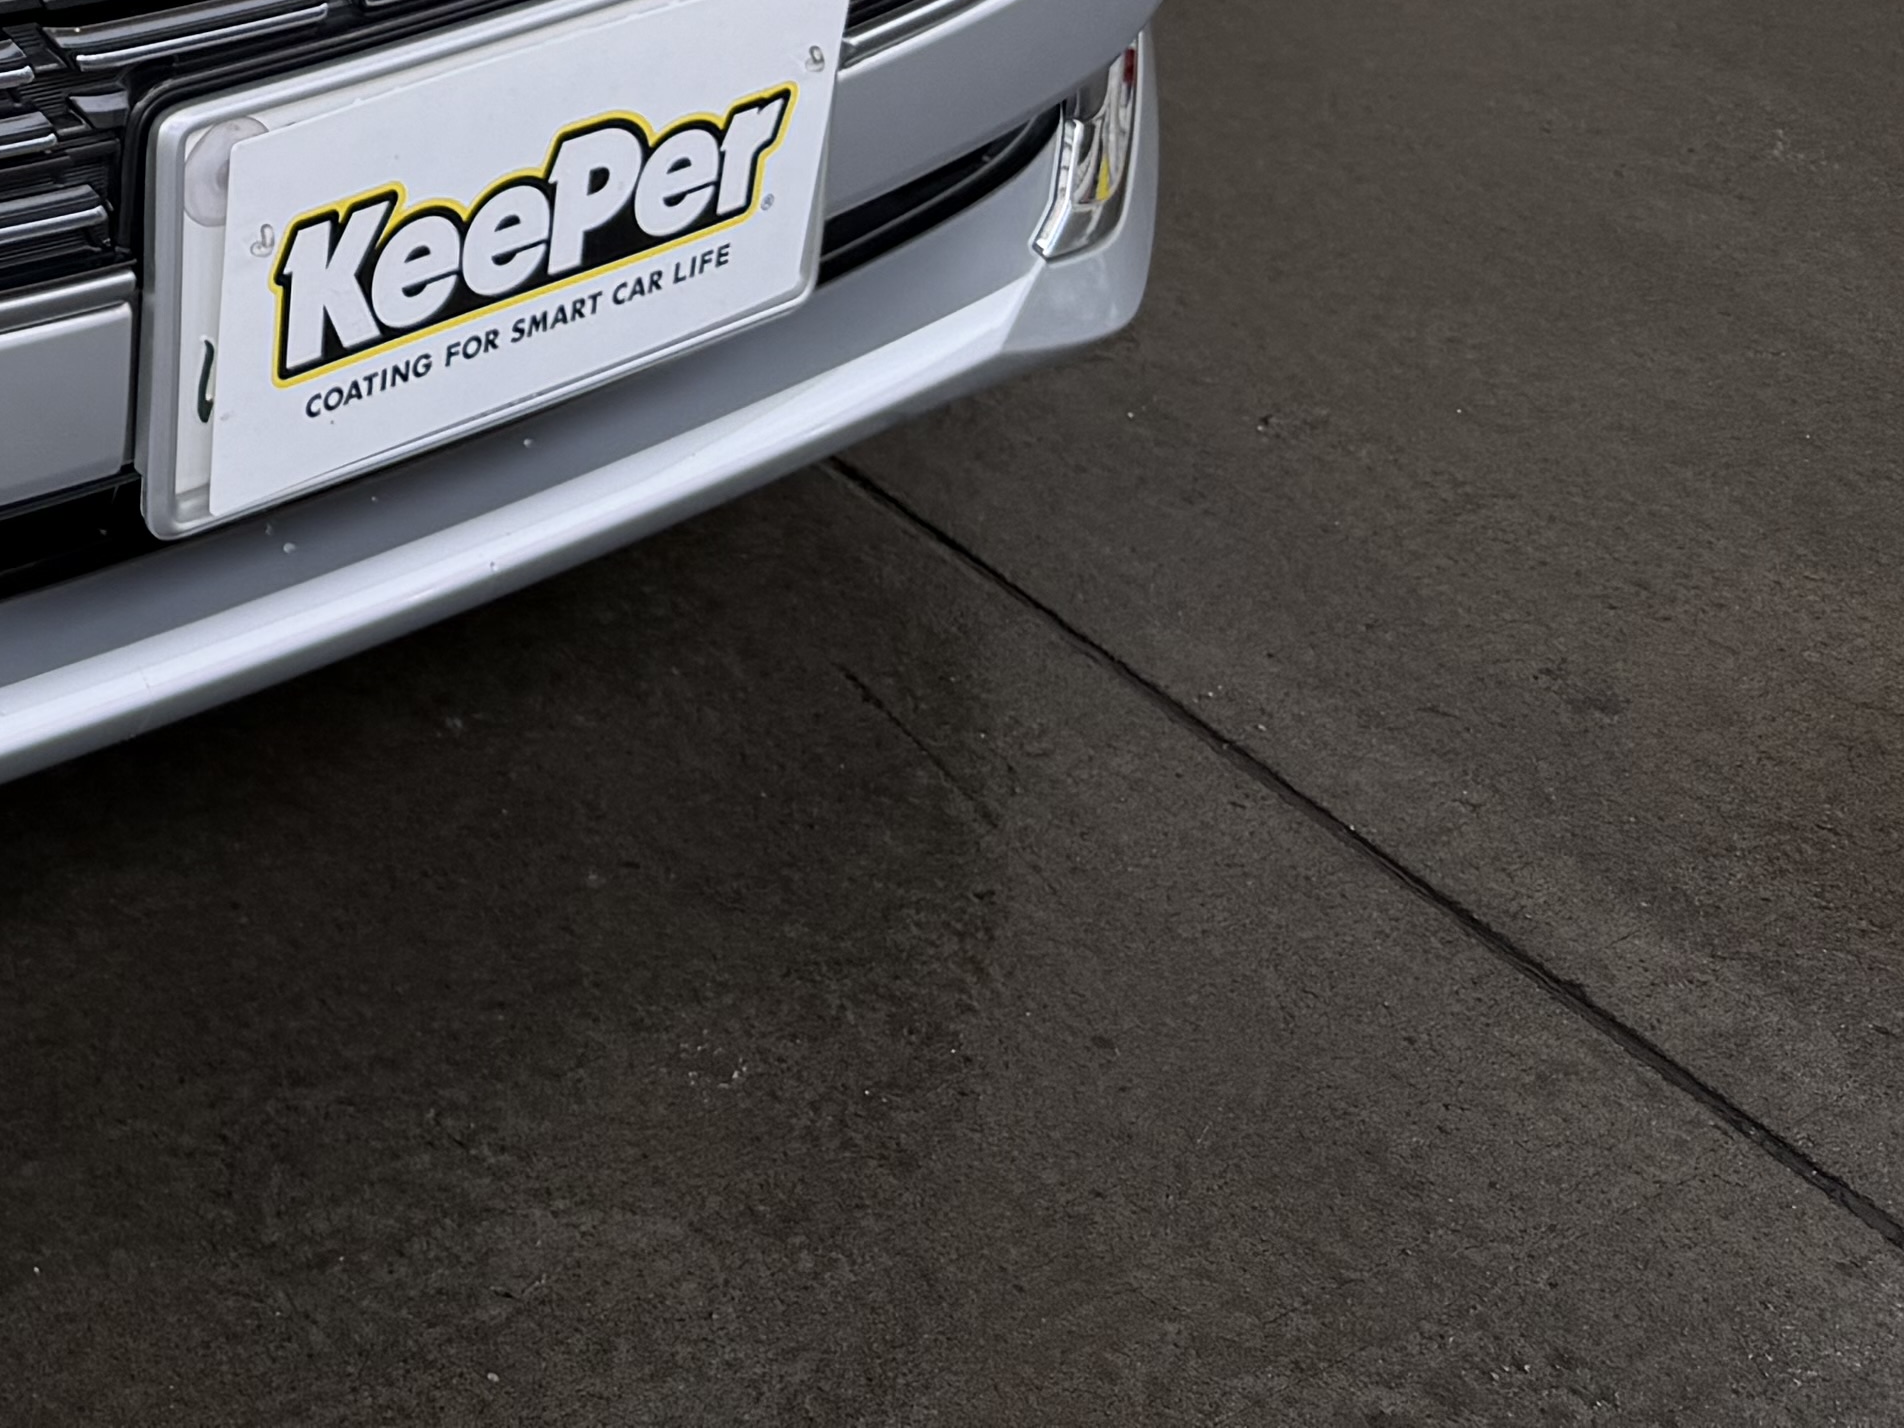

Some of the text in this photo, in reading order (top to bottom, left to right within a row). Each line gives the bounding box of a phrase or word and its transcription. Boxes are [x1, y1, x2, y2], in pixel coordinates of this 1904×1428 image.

[278, 91, 792, 378] KeePer
[305, 244, 731, 418] COATING FOR SMART CAR LIFE
